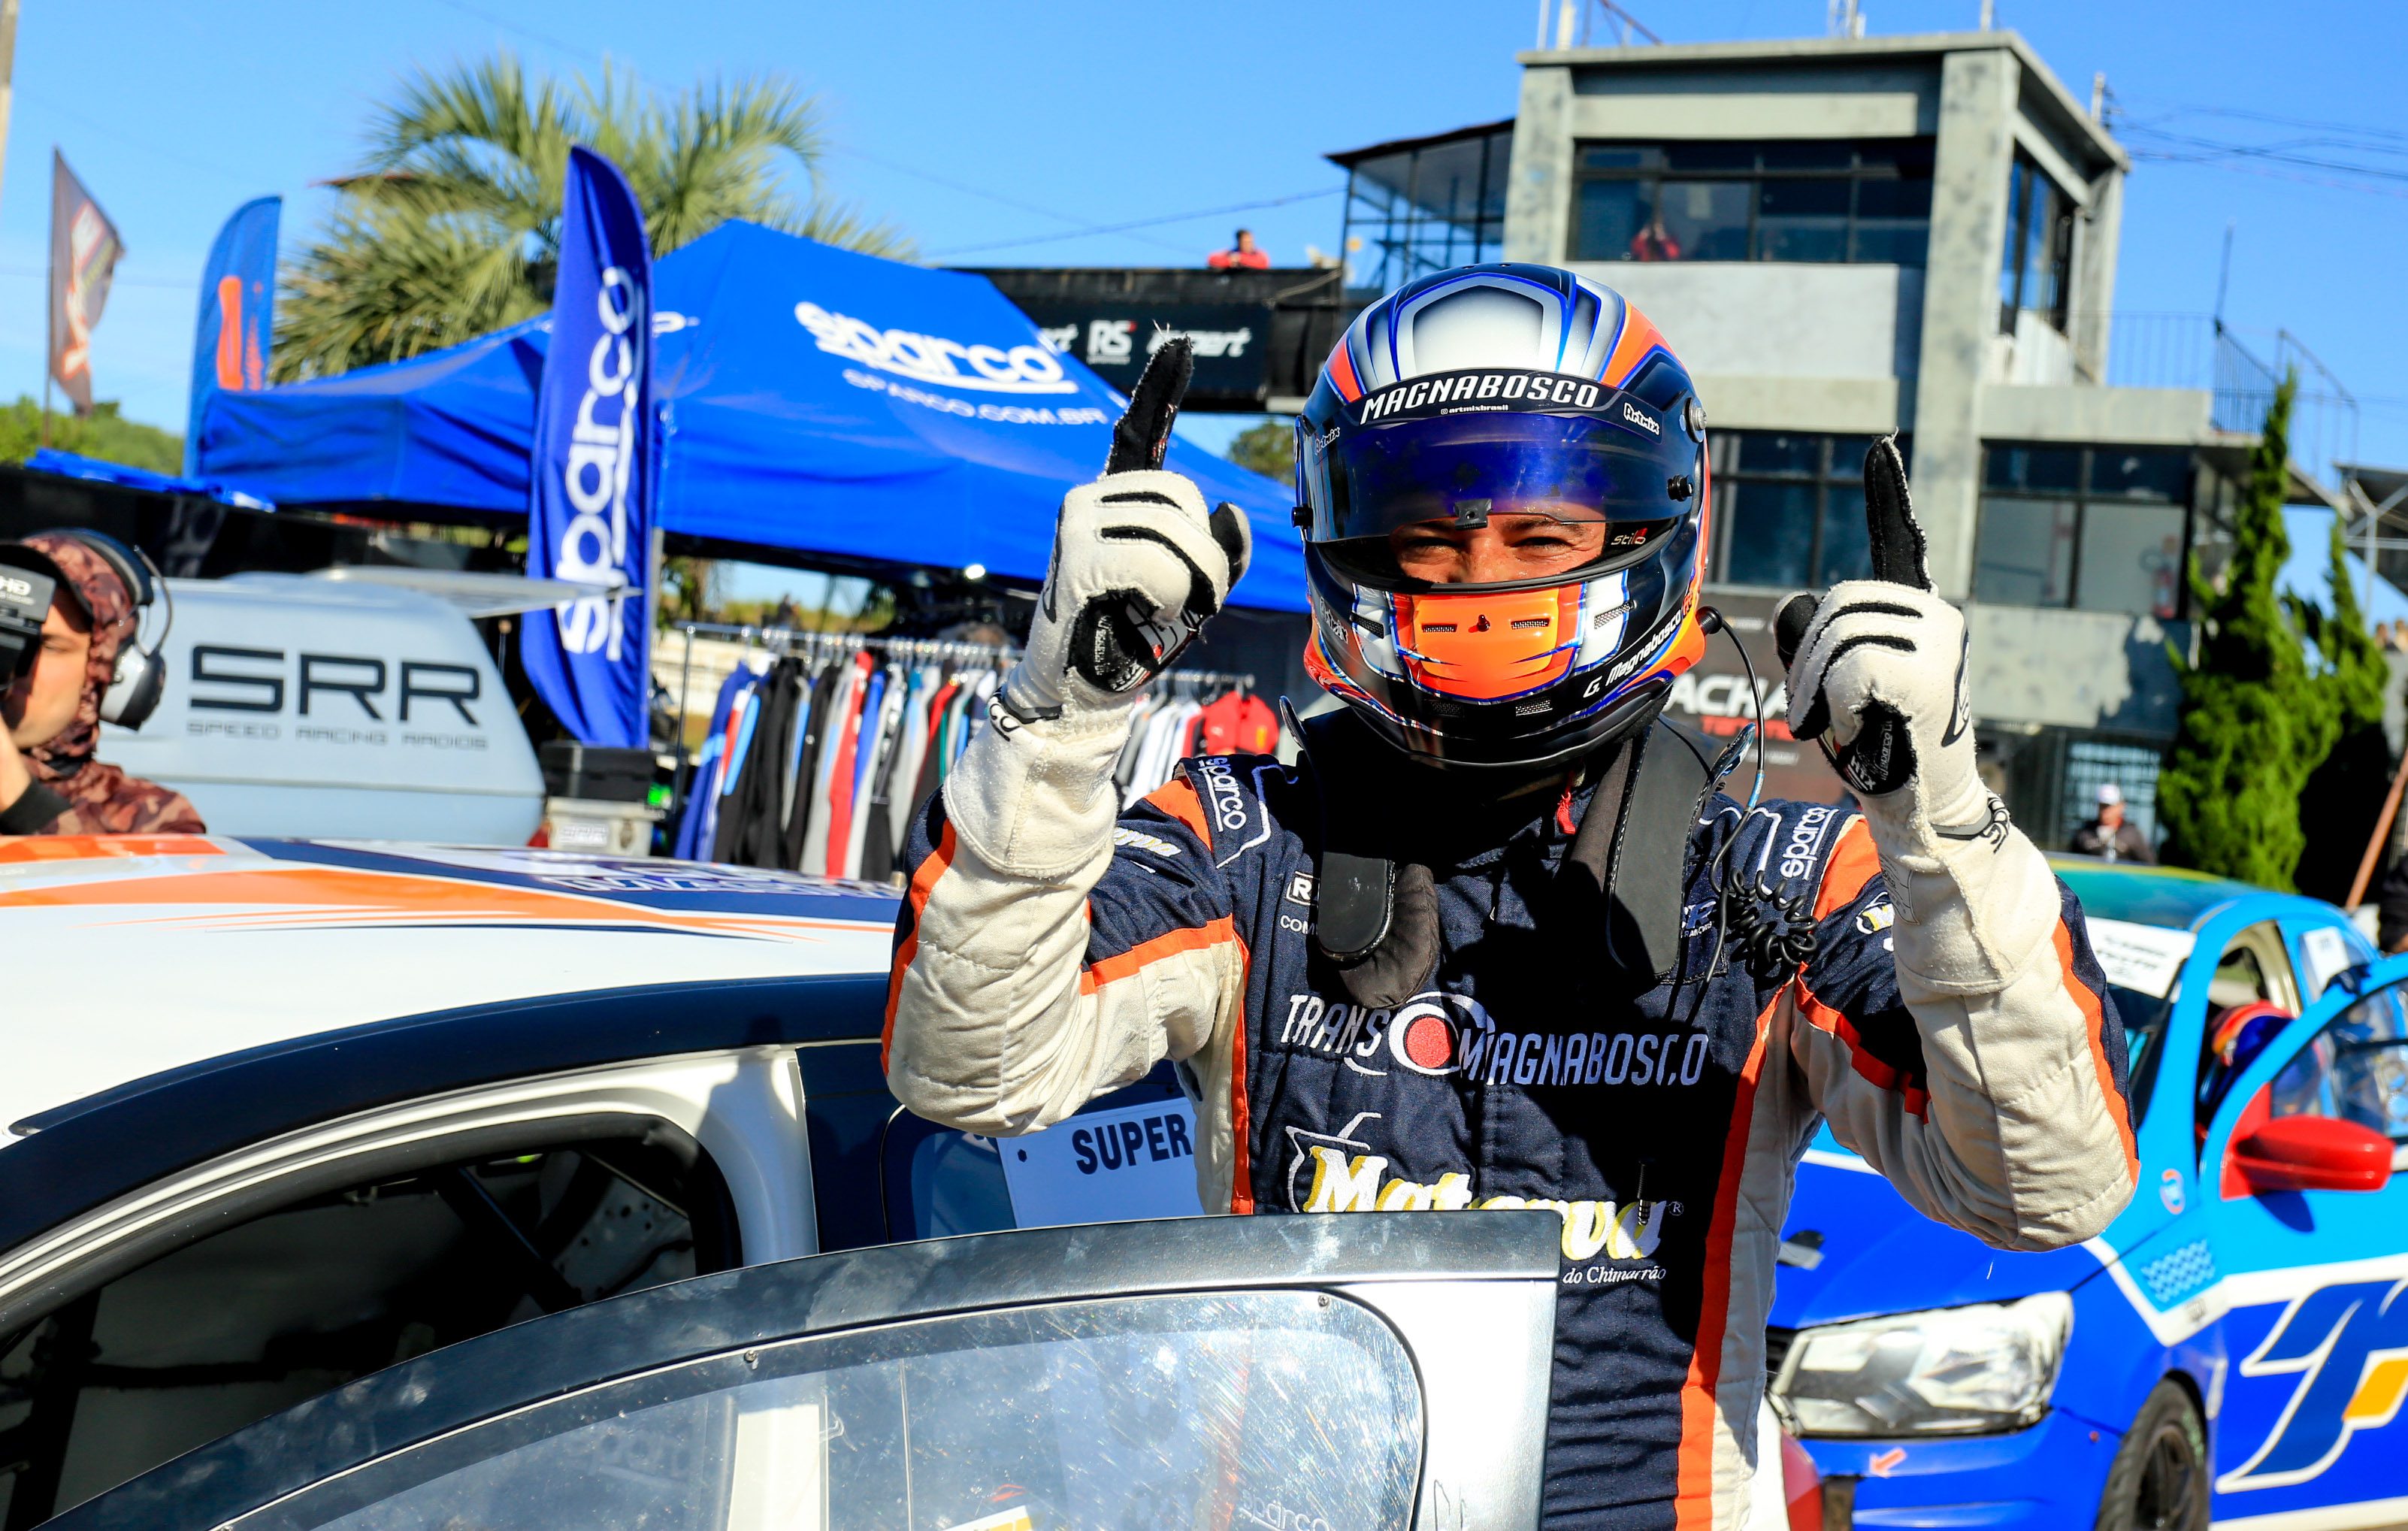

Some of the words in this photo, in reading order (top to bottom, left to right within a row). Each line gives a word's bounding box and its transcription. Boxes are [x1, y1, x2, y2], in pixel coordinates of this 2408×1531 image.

[794, 301, 1079, 394] sparco
[1359, 374, 1599, 425] MAGNABOSCO
[1623, 401, 1660, 436] Artmix
[555, 266, 643, 661] sparco
[189, 644, 481, 727] SRR
[1583, 675, 1603, 698] G.
[1605, 609, 1682, 687] Magnabosco
[186, 721, 283, 740] SPEED
[295, 725, 389, 746] RACING
[1198, 757, 1248, 833] sparco
[1281, 994, 1390, 1057] TRANS
[1458, 1029, 1709, 1086] MAGNABOSCO
[1072, 1113, 1193, 1175] SUPER
[1562, 1267, 1584, 1284] do
